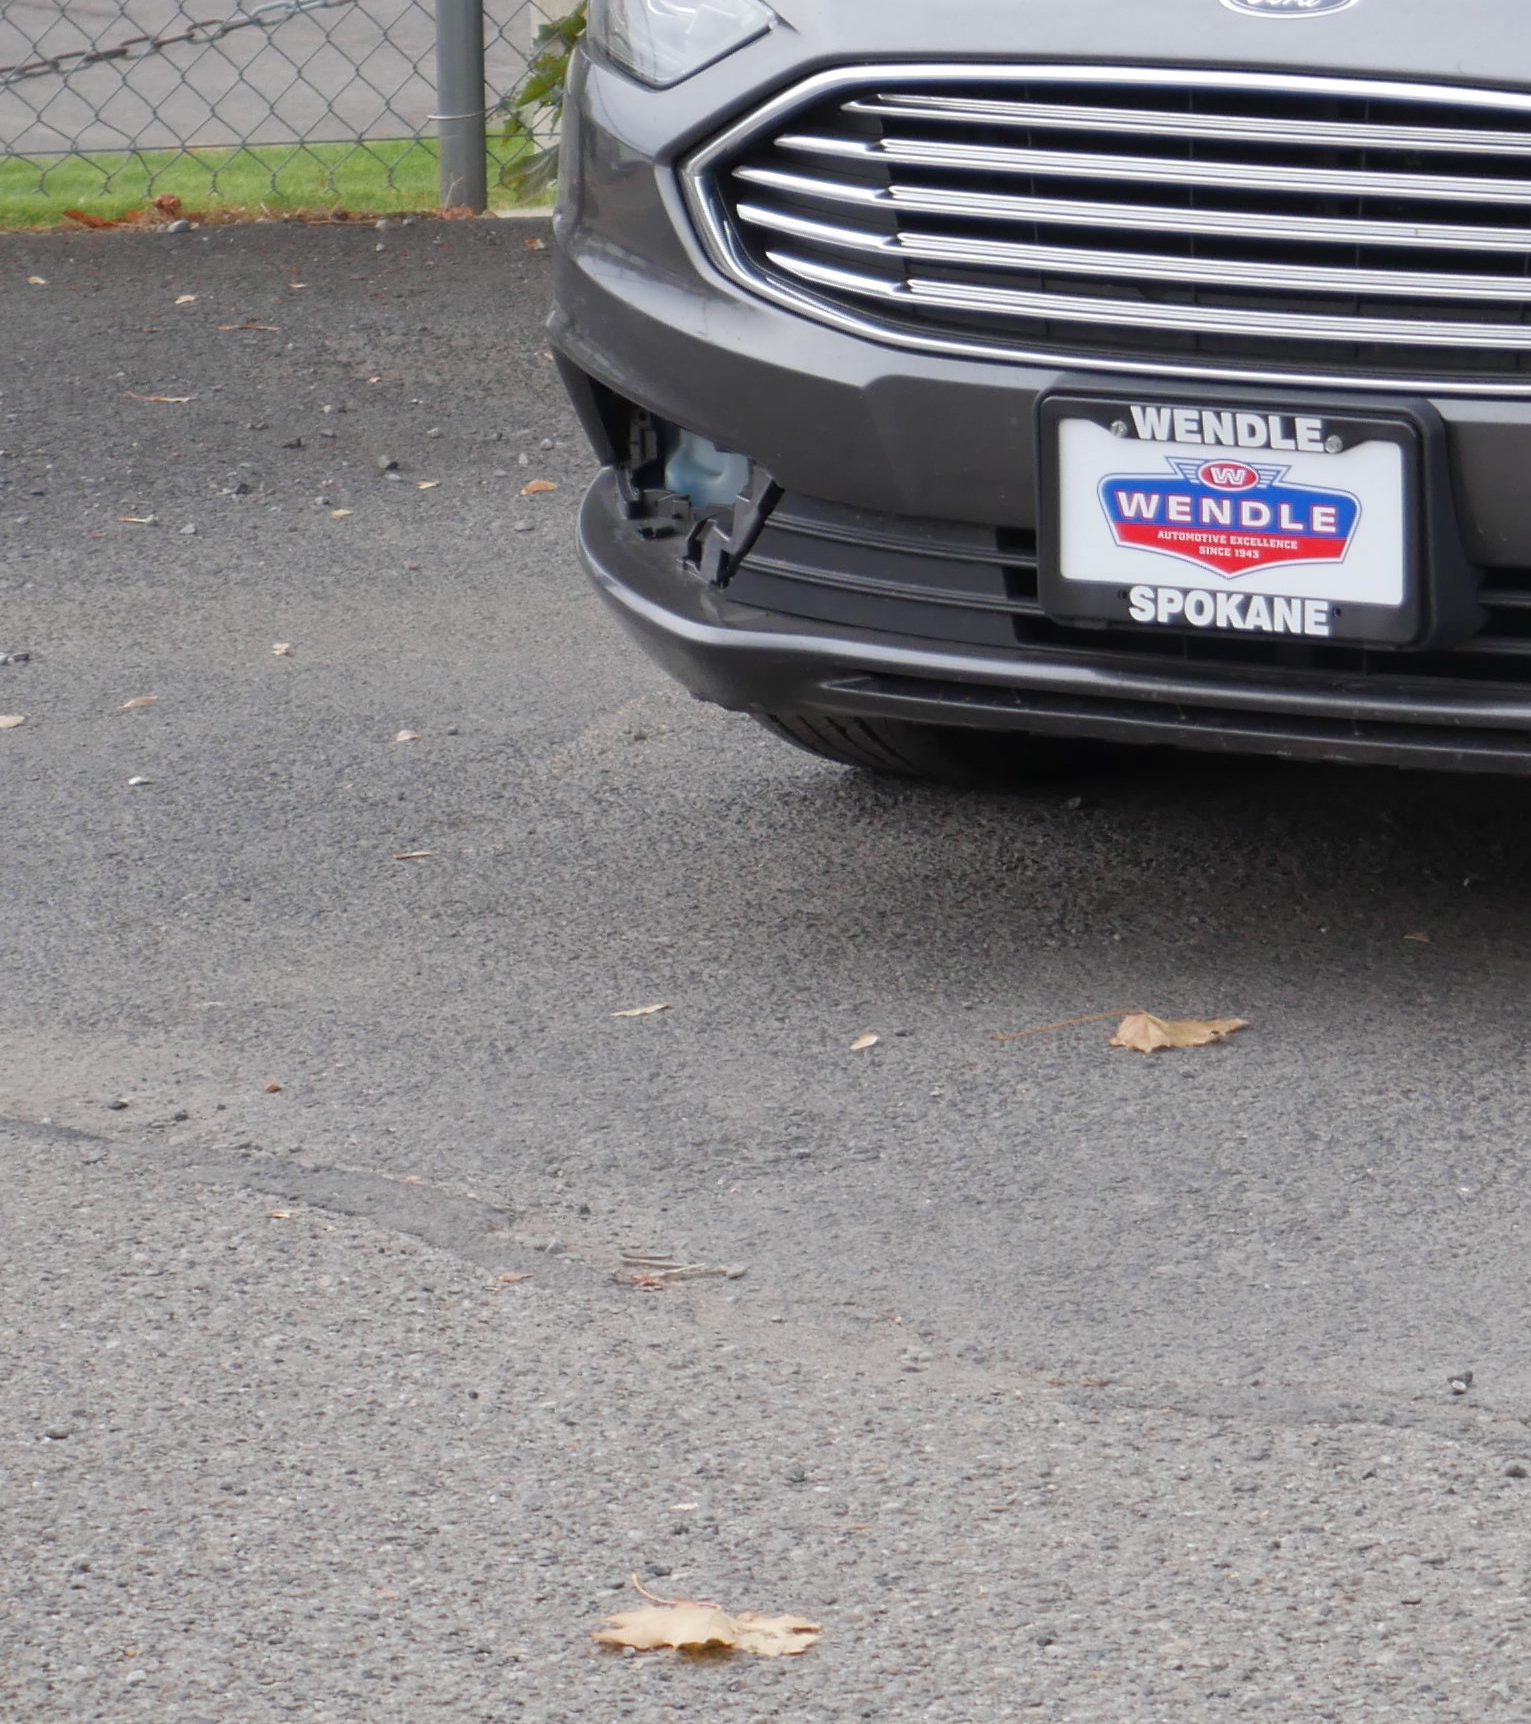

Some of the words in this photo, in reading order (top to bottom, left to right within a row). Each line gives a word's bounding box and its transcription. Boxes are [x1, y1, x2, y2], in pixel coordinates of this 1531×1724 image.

[1130, 405, 1325, 452] WENDLE
[1116, 490, 1338, 534] WENDLE
[1157, 530, 1227, 544] AUTOMOTIVE
[1229, 535, 1299, 550] EXCELLENCE
[1198, 545, 1232, 557] SINCE
[1234, 548, 1260, 559] 1943
[1128, 585, 1330, 636] SPOKANE
